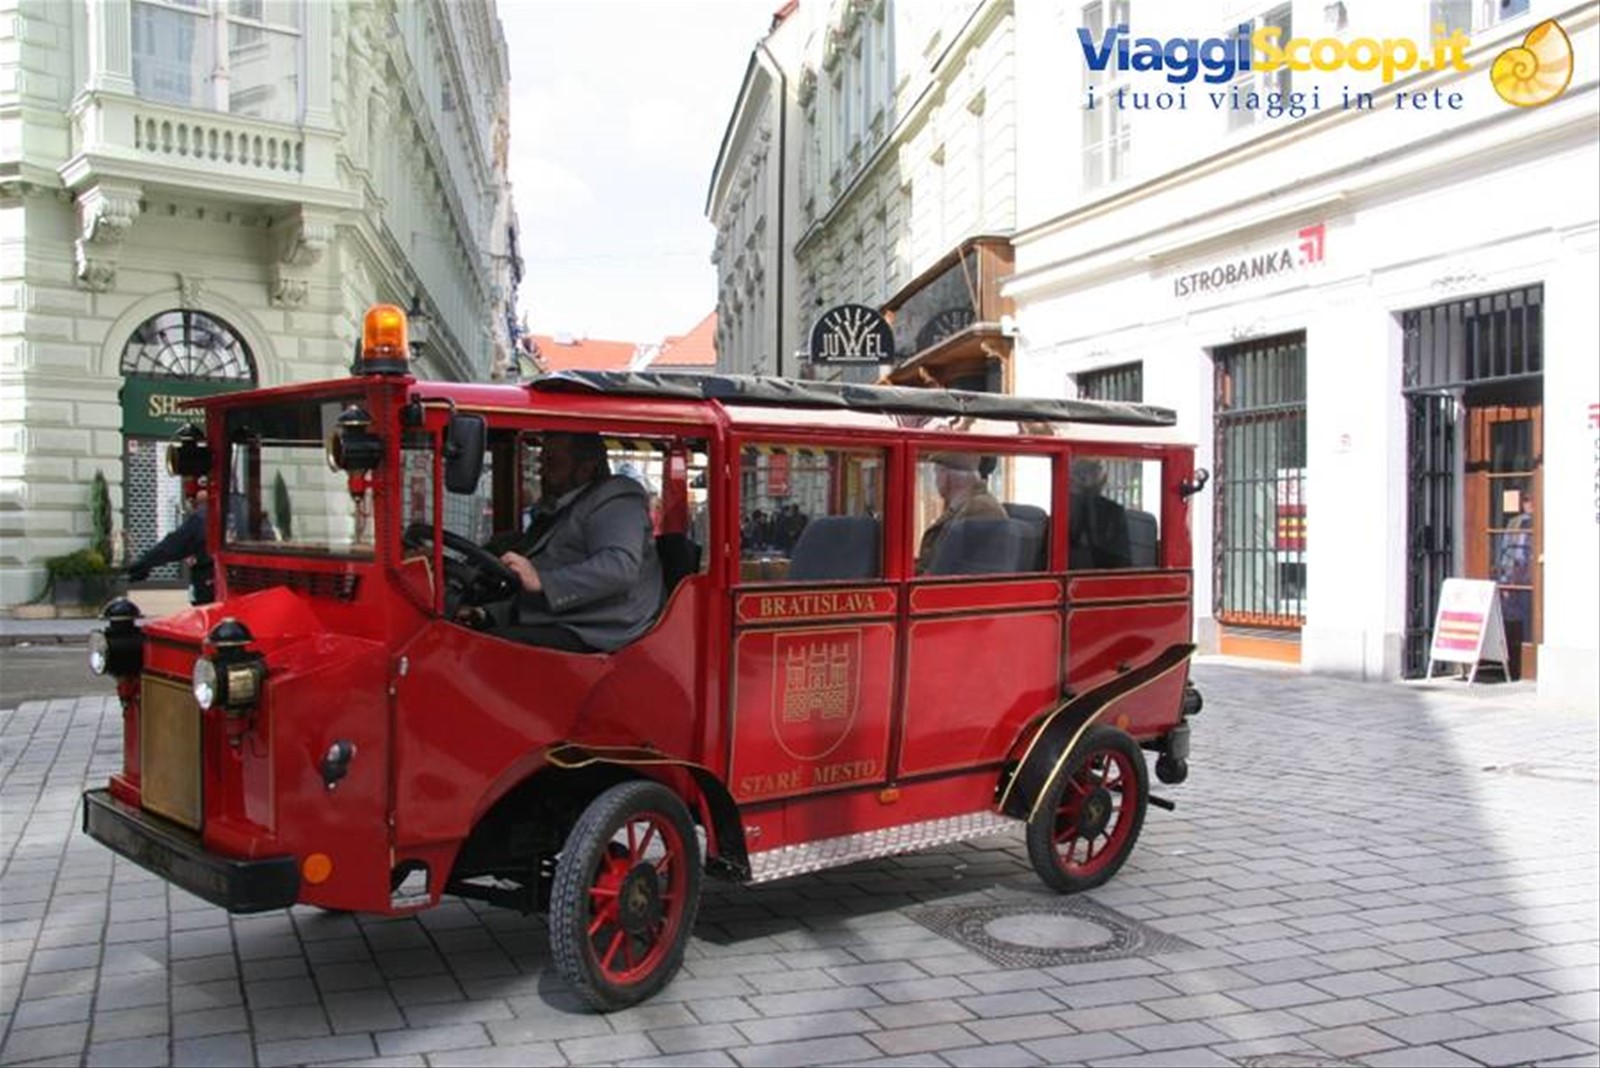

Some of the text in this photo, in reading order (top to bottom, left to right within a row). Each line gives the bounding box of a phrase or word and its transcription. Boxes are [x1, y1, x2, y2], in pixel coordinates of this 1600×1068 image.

[1174, 249, 1294, 298] ISTROBANKA
[818, 320, 888, 357] JUWEL
[760, 592, 875, 617] BRATISLAVA
[812, 758, 877, 785] MESTO
